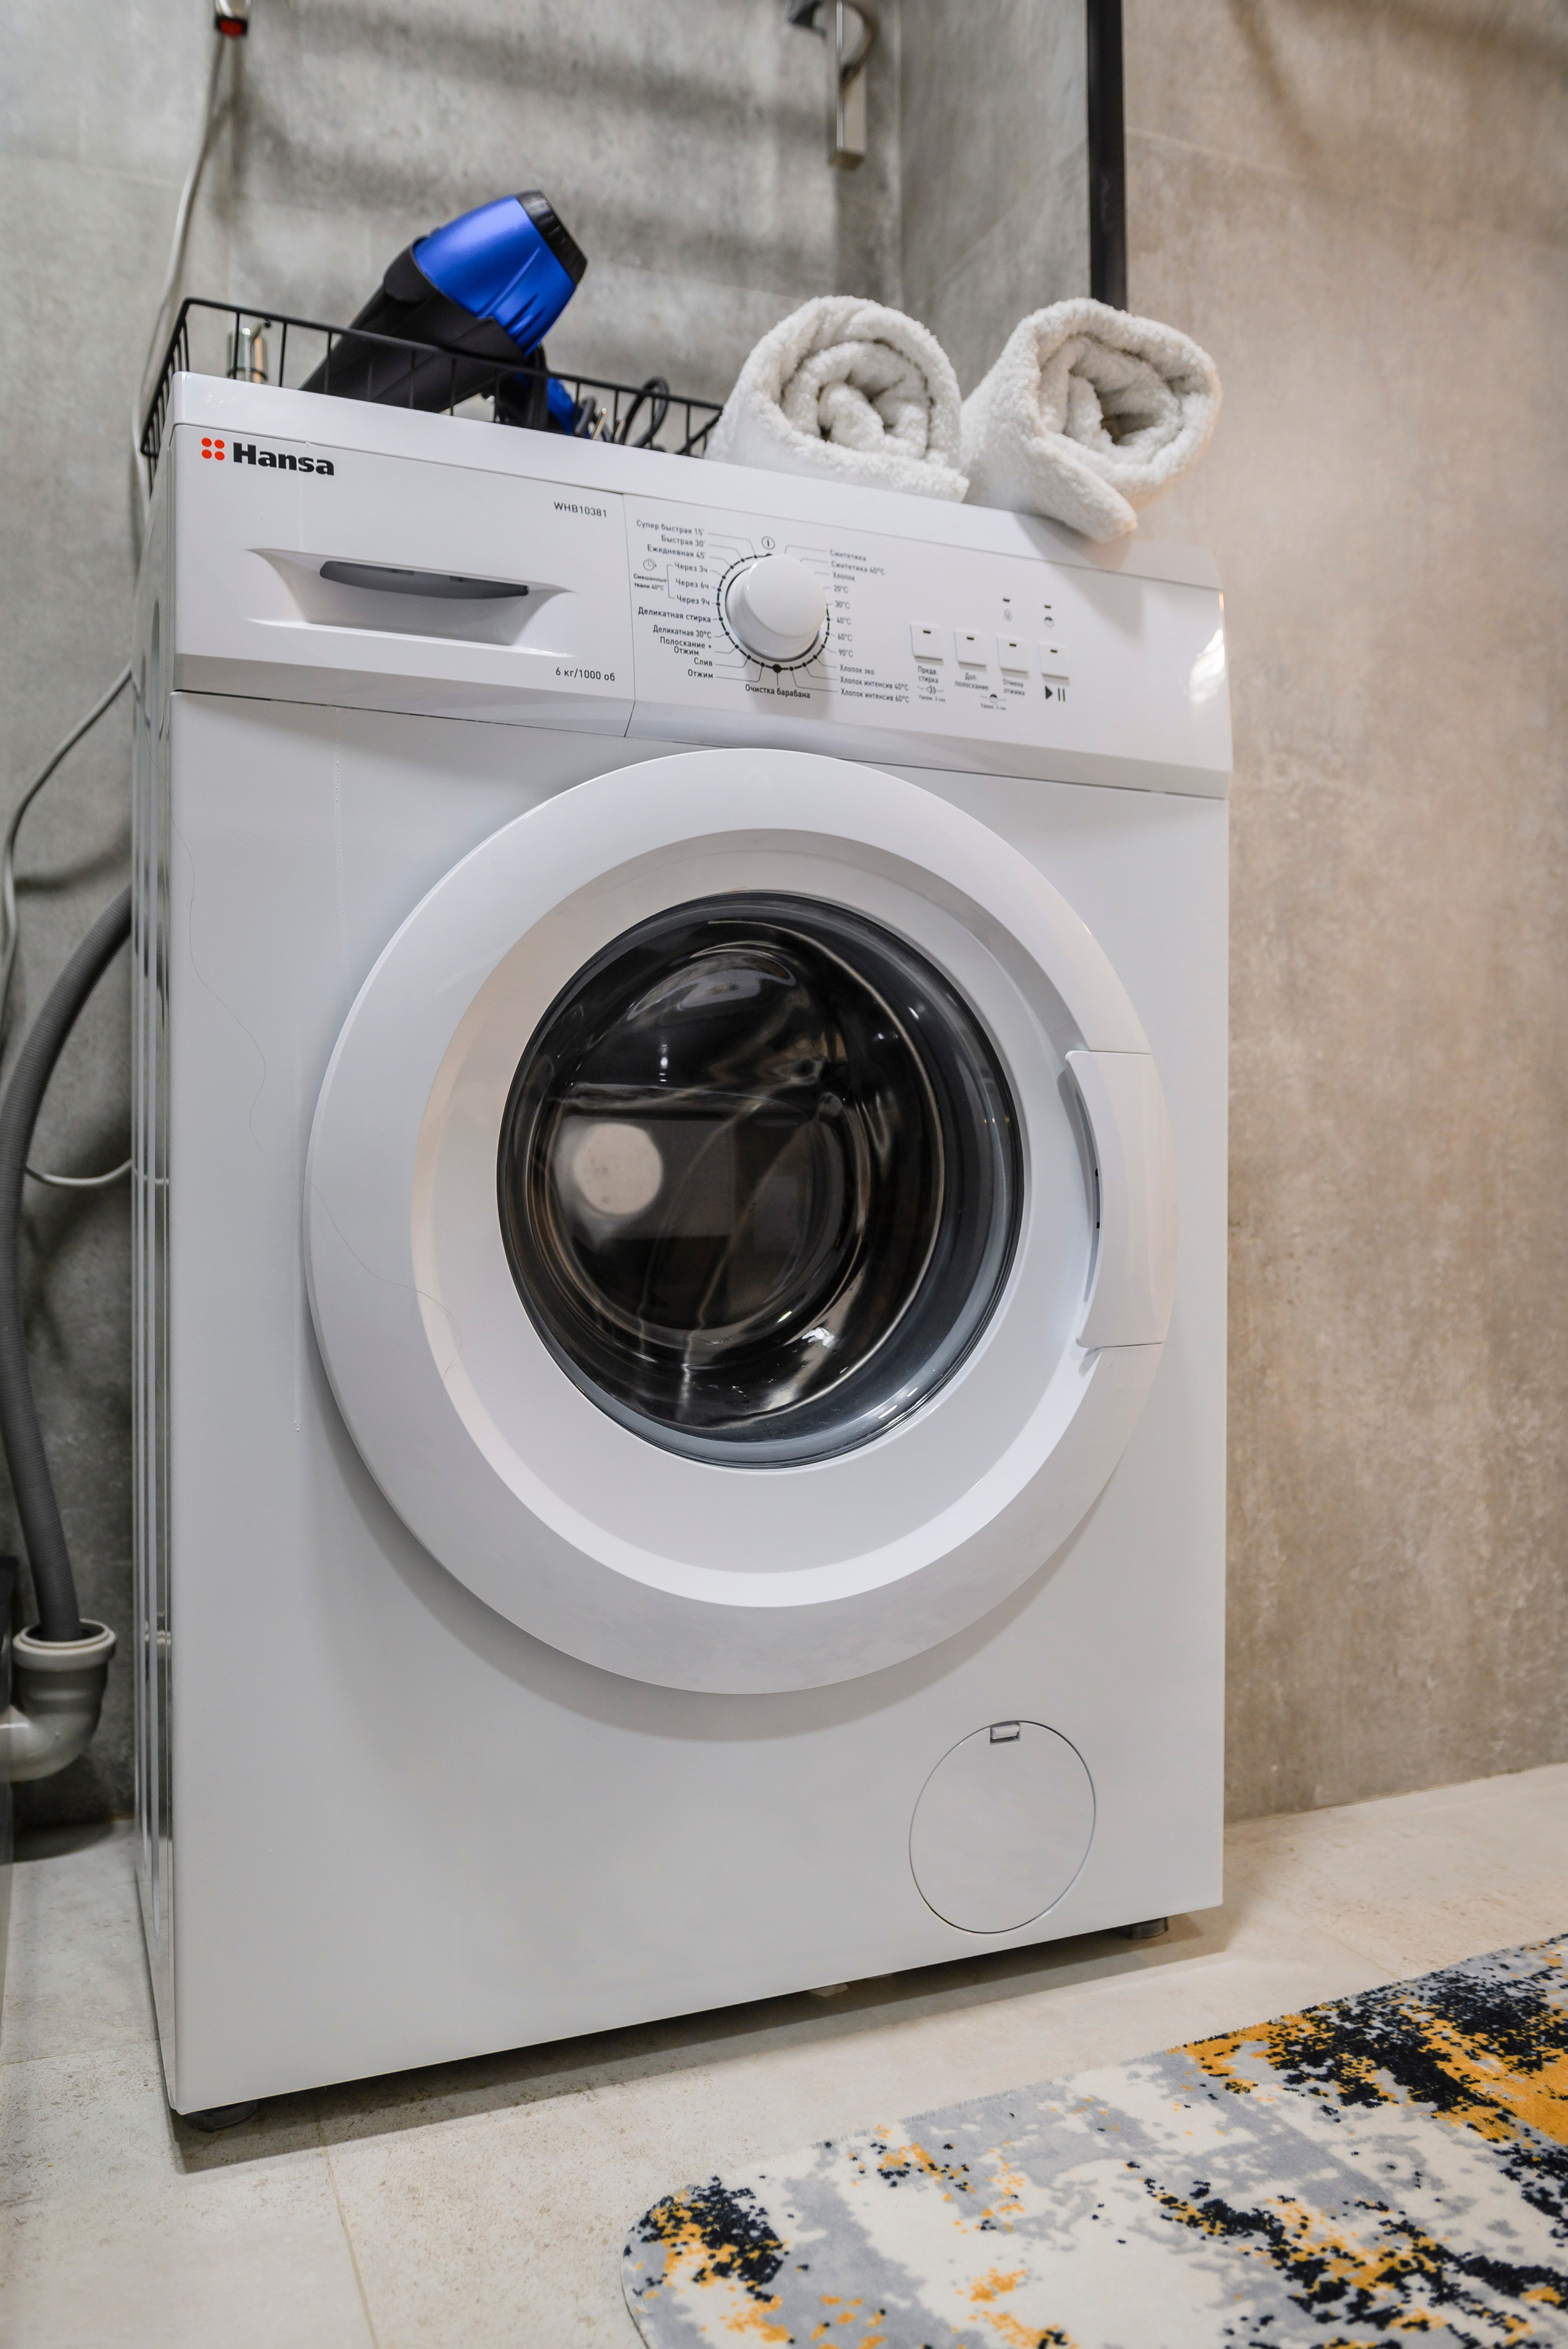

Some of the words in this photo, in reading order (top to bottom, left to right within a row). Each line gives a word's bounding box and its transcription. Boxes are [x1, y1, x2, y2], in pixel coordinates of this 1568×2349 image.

[233, 442, 334, 476] Hansa
[554, 501, 606, 518] WHB10381
[636, 519, 659, 530] Супер
[662, 523, 692, 534] быстрая
[662, 535, 693, 545] Быстрая
[647, 544, 694, 557] Ежедневная
[674, 562, 697, 571] Через
[676, 578, 698, 588] Через
[676, 595, 699, 605] Через
[638, 606, 684, 618] Деликатная
[653, 625, 694, 636] Деликатная
[660, 636, 706, 649] Полоскание
[674, 646, 699, 655] Отжим
[694, 657, 712, 666] Слив
[556, 667, 561, 676] 6
[564, 668, 601, 680] кг/1000
[604, 673, 615, 681] об
[688, 669, 713, 679] Отжим
[840, 664, 862, 673] Хлопок
[840, 676, 862, 685] Хлопок
[864, 681, 893, 689] интенсив
[745, 684, 775, 695] Очистка
[777, 688, 810, 699] барабана
[841, 688, 863, 698] Хлопок
[865, 693, 894, 701] интенсив
